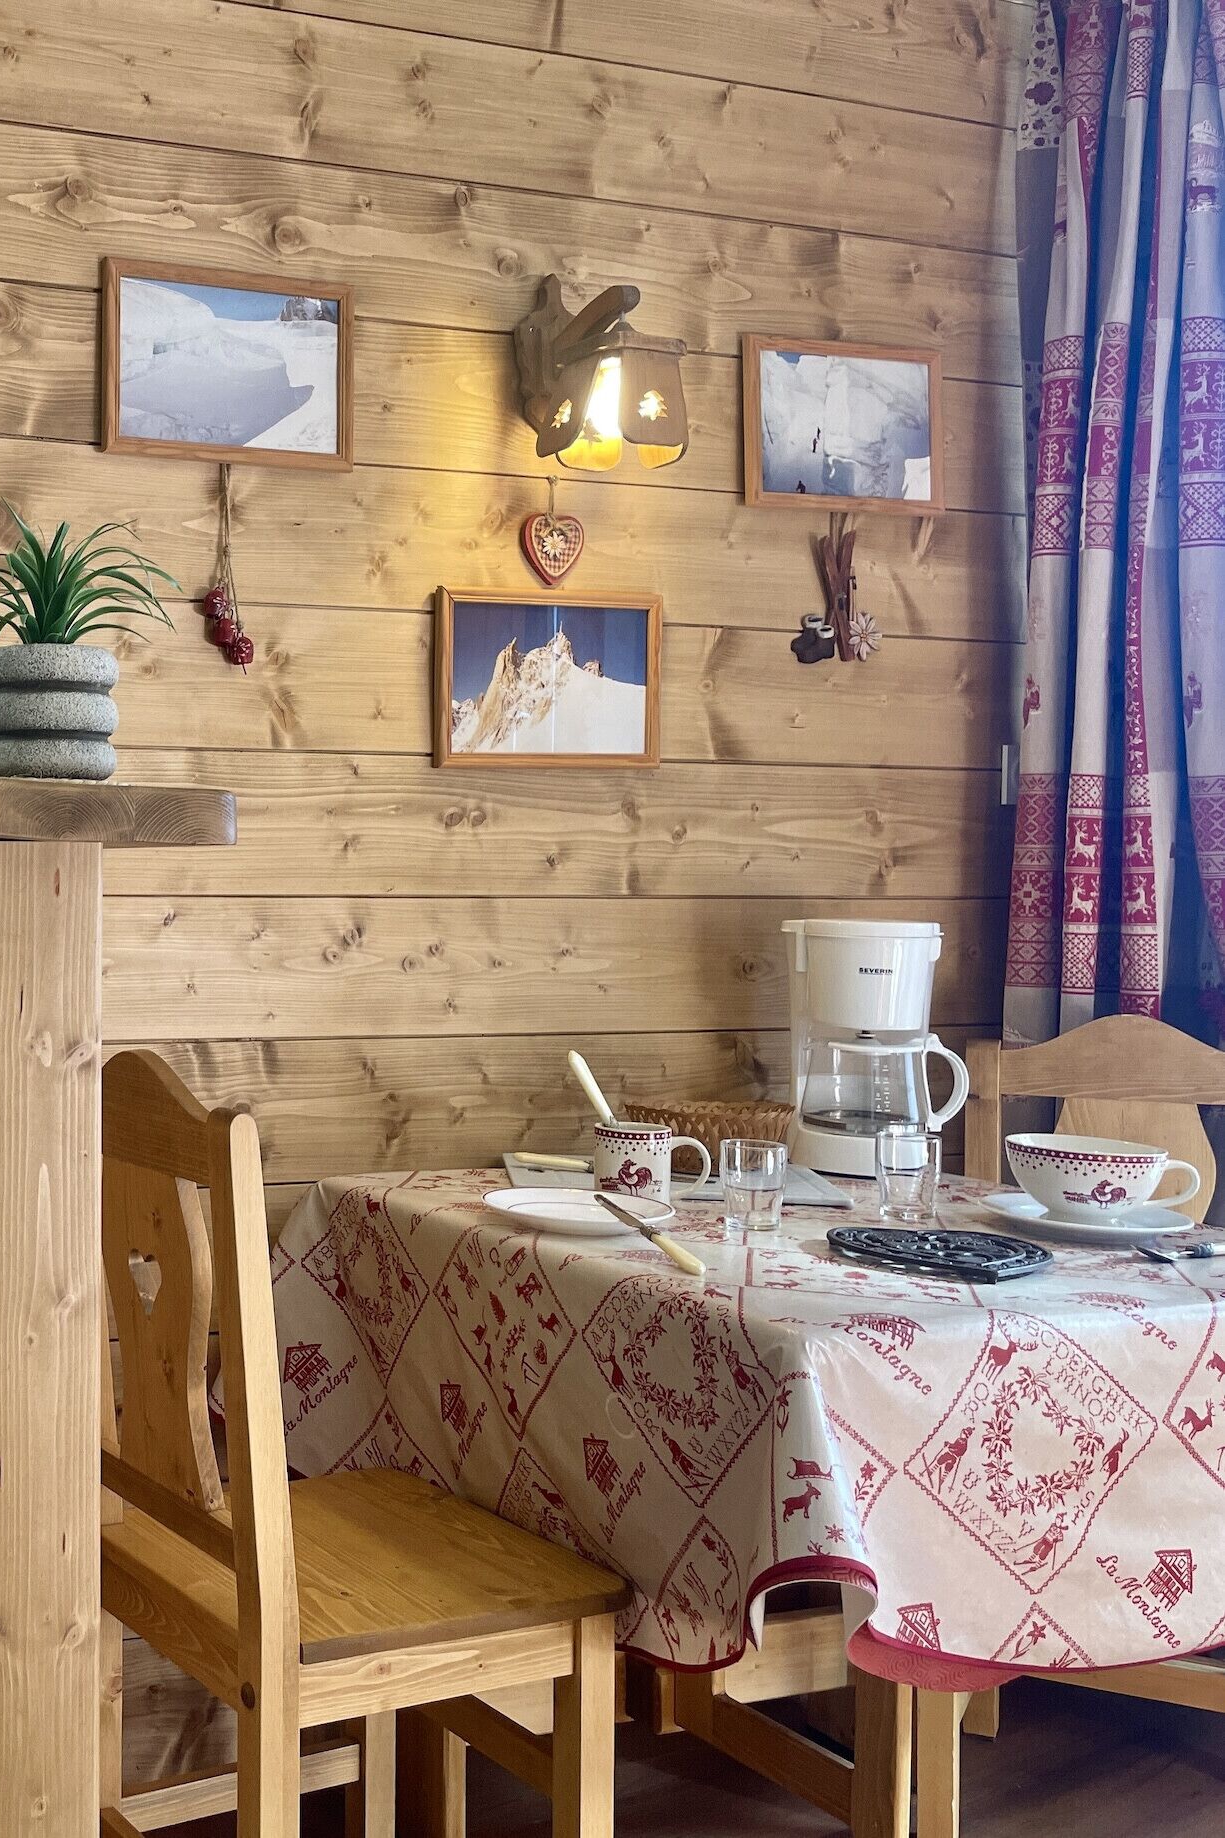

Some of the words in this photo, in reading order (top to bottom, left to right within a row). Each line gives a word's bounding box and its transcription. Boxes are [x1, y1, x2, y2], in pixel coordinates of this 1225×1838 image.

[297, 1354, 358, 1422] Montagne
[812, 1320, 932, 1396] Montagne
[607, 1461, 647, 1531] Montagne
[1096, 1555, 1119, 1577] La
[1114, 1576, 1181, 1649] Montagne
